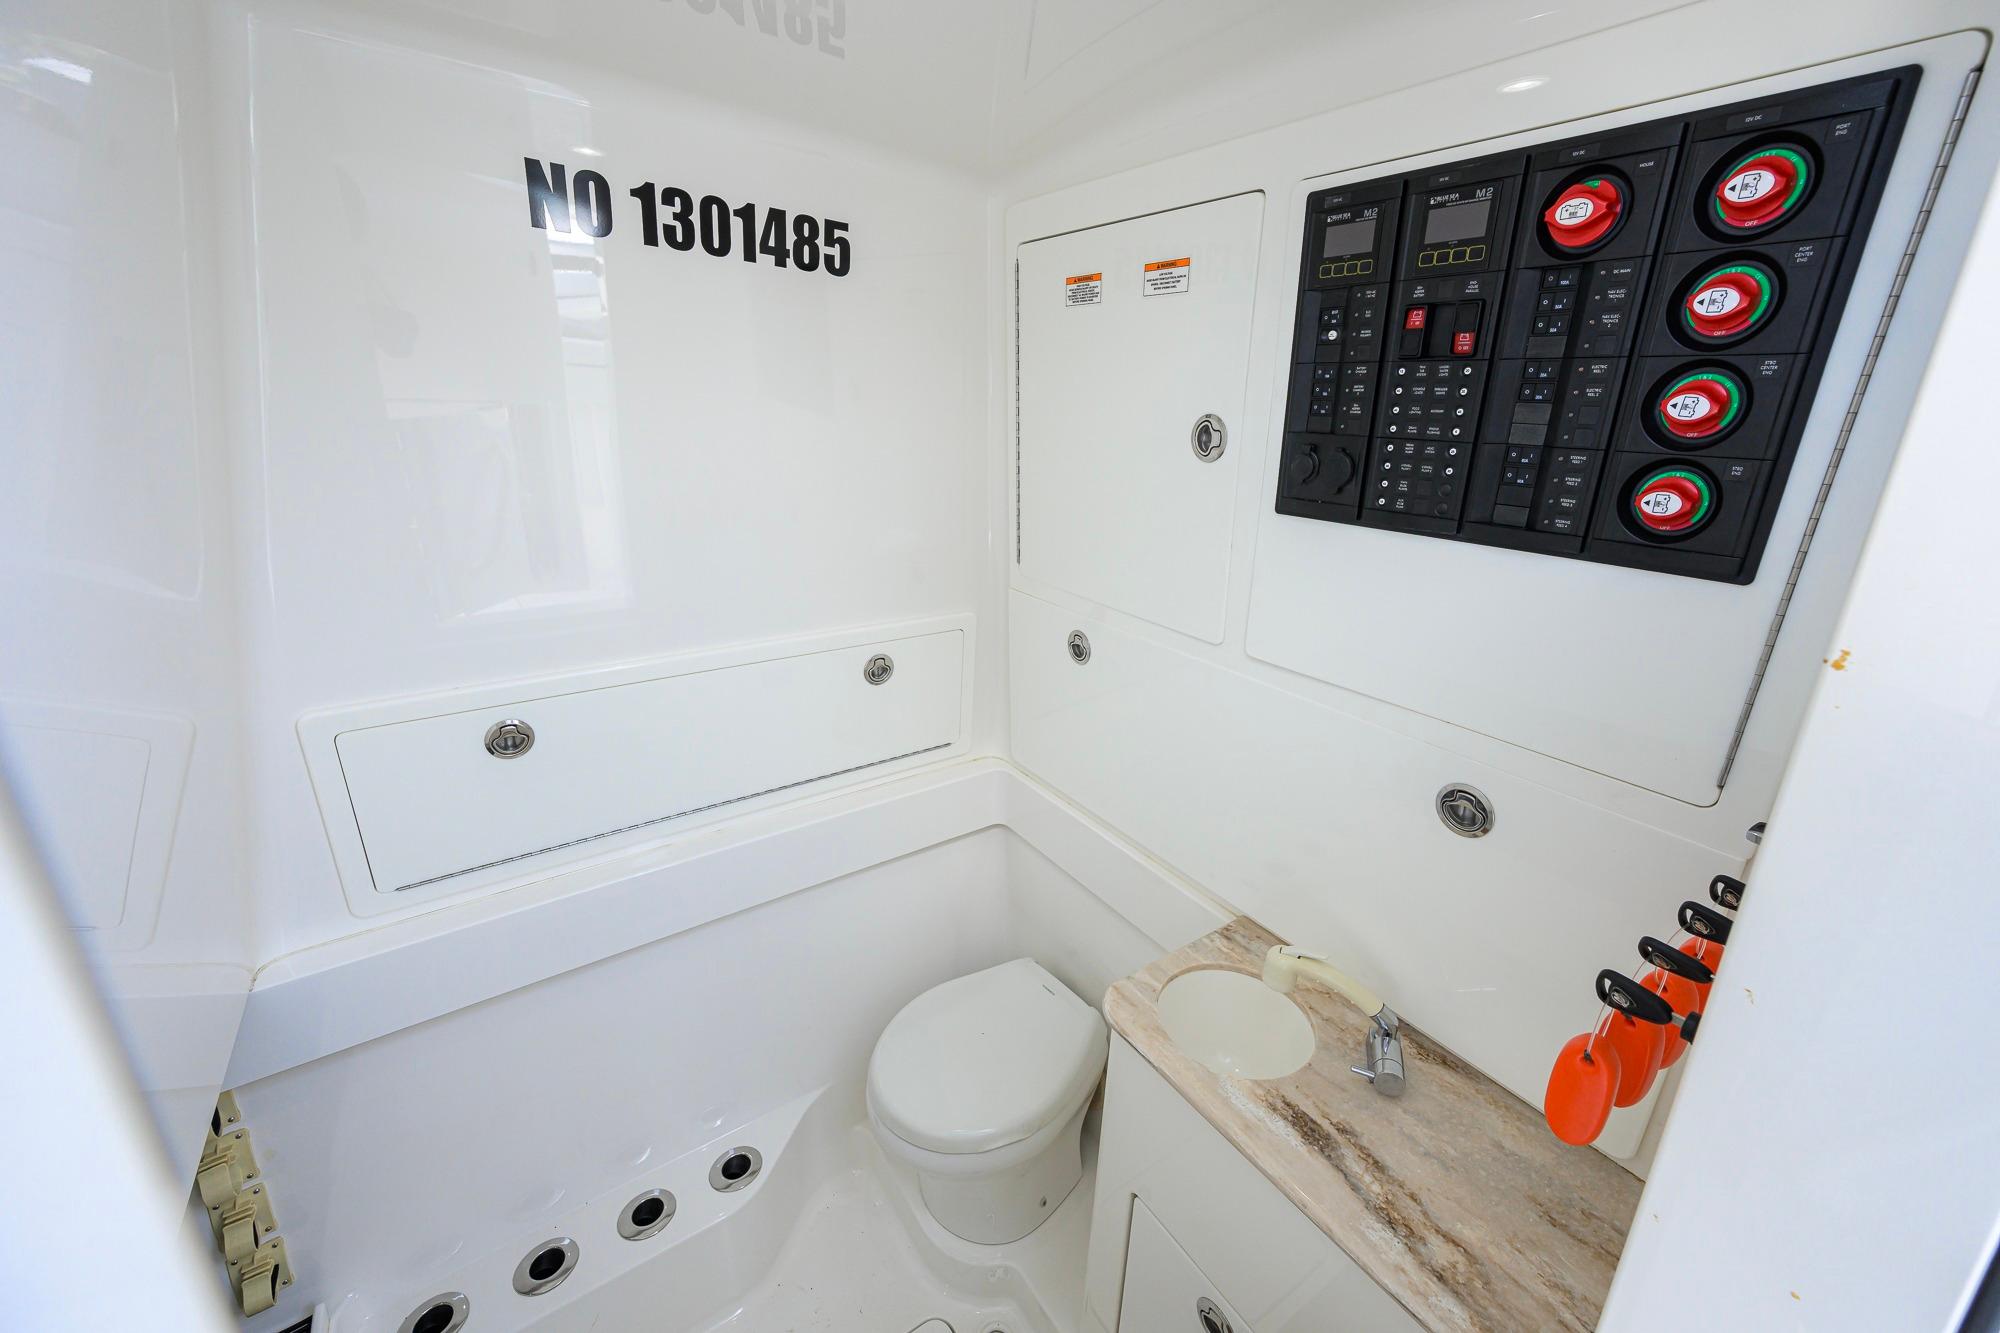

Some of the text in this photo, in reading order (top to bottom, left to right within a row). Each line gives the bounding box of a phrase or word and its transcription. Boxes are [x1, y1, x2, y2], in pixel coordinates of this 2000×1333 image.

[1835, 122, 1852, 130] PORT
[1475, 187, 1494, 198] M2
[1363, 207, 1378, 217] M2
[524, 157, 851, 278] NO 1301485
[1745, 219, 1760, 227] OFF
